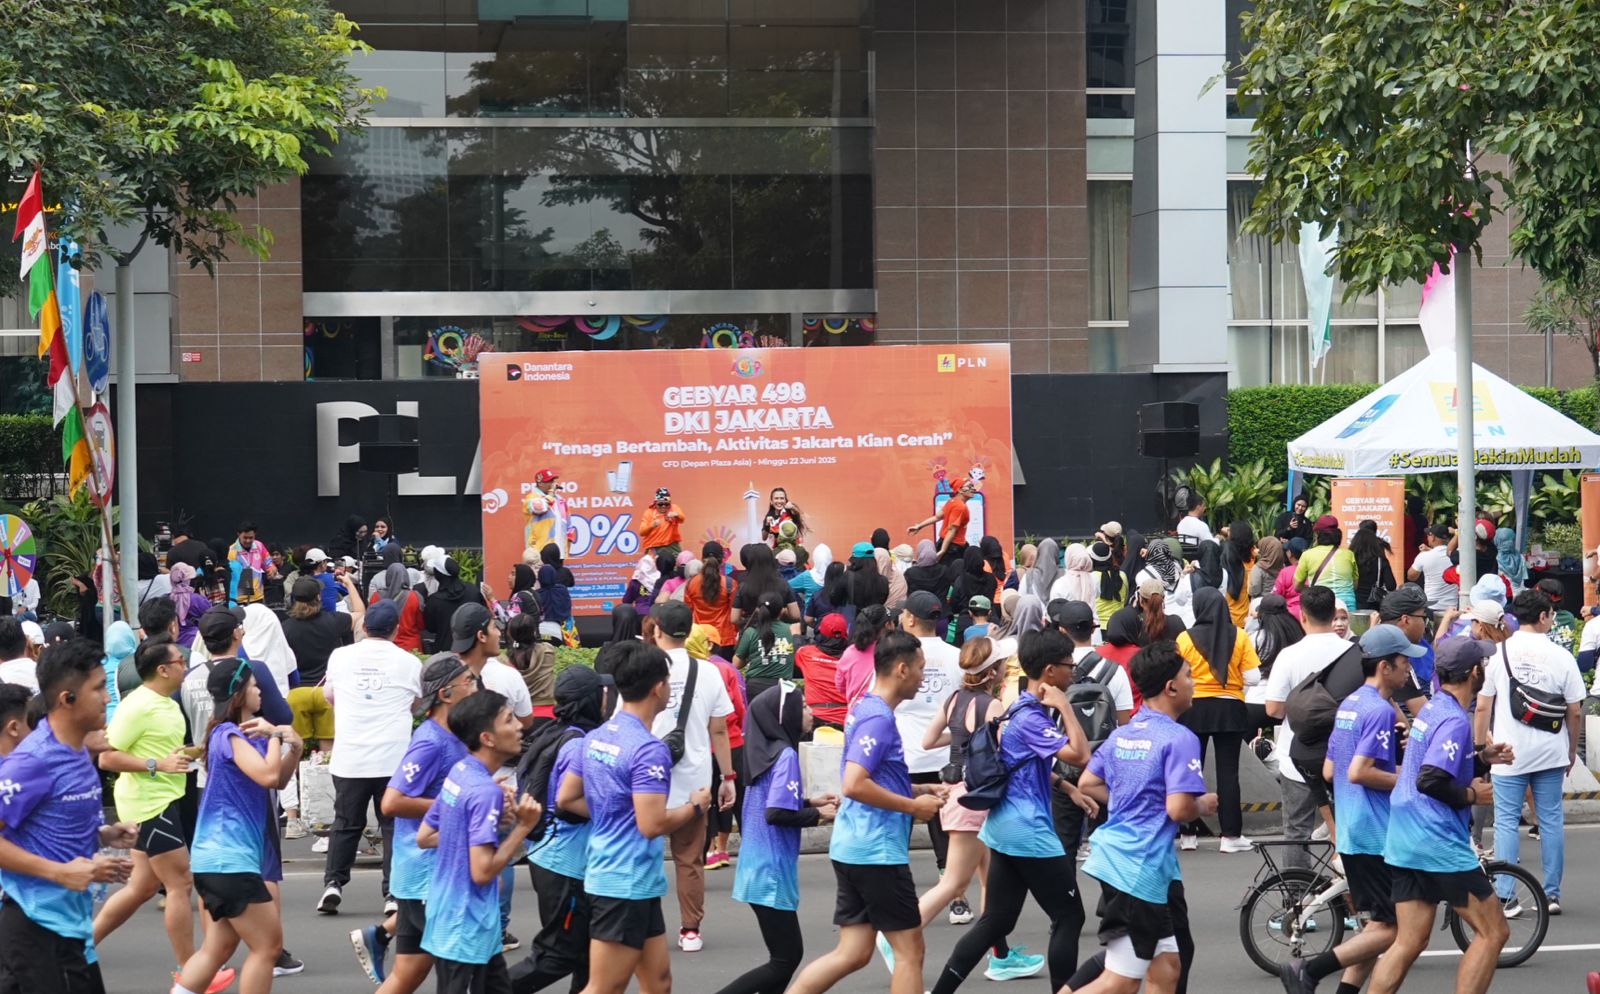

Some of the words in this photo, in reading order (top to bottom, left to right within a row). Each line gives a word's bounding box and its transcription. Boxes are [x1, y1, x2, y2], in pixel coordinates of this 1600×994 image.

[523, 363, 573, 371] Danantara
[957, 357, 988, 368] PLN
[524, 371, 571, 381] Indonesia
[663, 384, 758, 407] GEBYAR
[761, 382, 806, 403] 498
[664, 411, 710, 435] DKI
[715, 406, 834, 432] JAKARTA
[616, 440, 712, 455] Bertambah,
[716, 435, 788, 451] Aktivitas
[792, 435, 853, 450] Jakarta
[857, 433, 893, 447] Kian
[662, 460, 680, 468] CFD
[681, 460, 709, 468] (Depan
[711, 459, 731, 467] Plaza
[732, 459, 752, 467] Asia)
[758, 458, 788, 467] Minggu
[789, 457, 799, 465] 22
[799, 457, 816, 465] Juni
[817, 456, 837, 464] 2025
[1389, 446, 1581, 469] #SemuaakinMudah
[591, 495, 633, 508] DAYA
